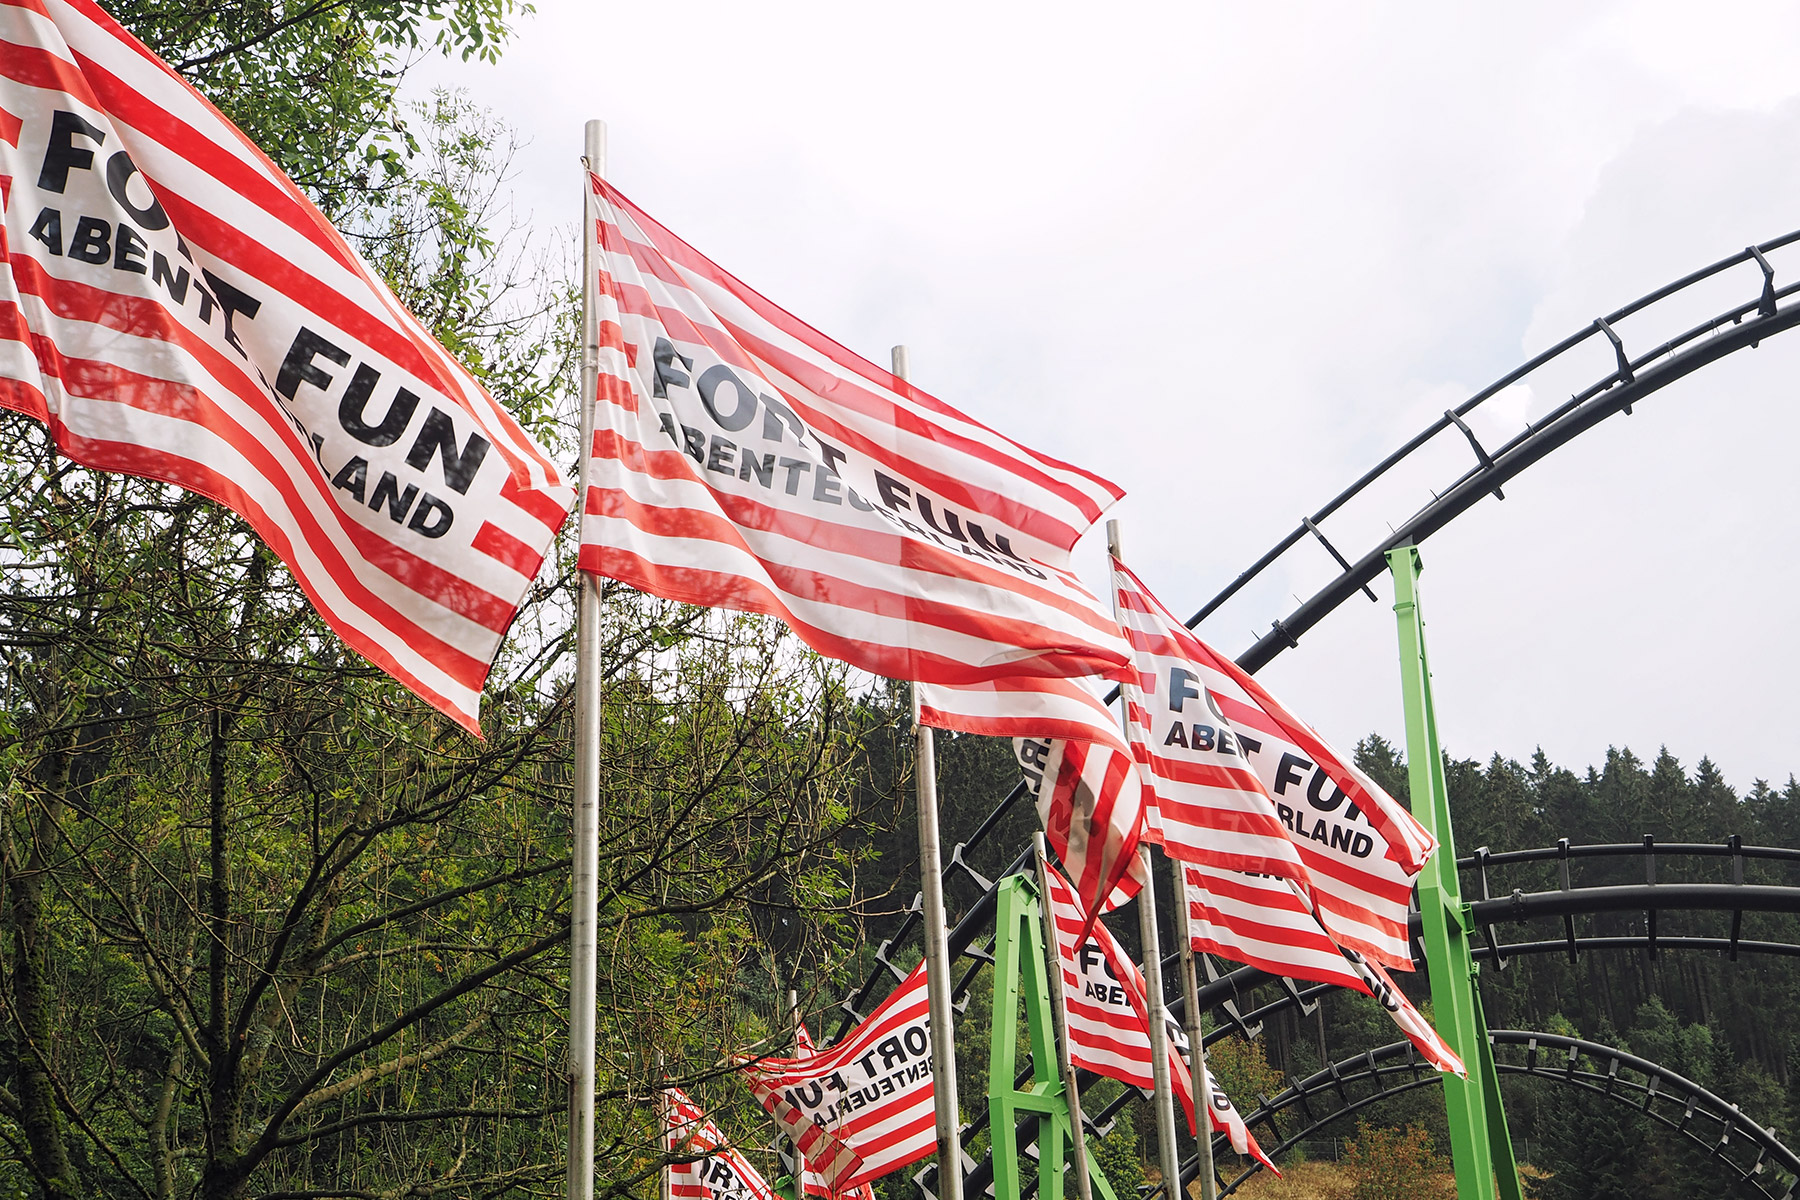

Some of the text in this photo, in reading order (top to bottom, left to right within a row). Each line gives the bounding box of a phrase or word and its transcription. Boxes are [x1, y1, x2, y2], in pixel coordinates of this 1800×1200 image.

[37, 110, 491, 497] FOT FUN
[653, 336, 1030, 565] FORT FUN
